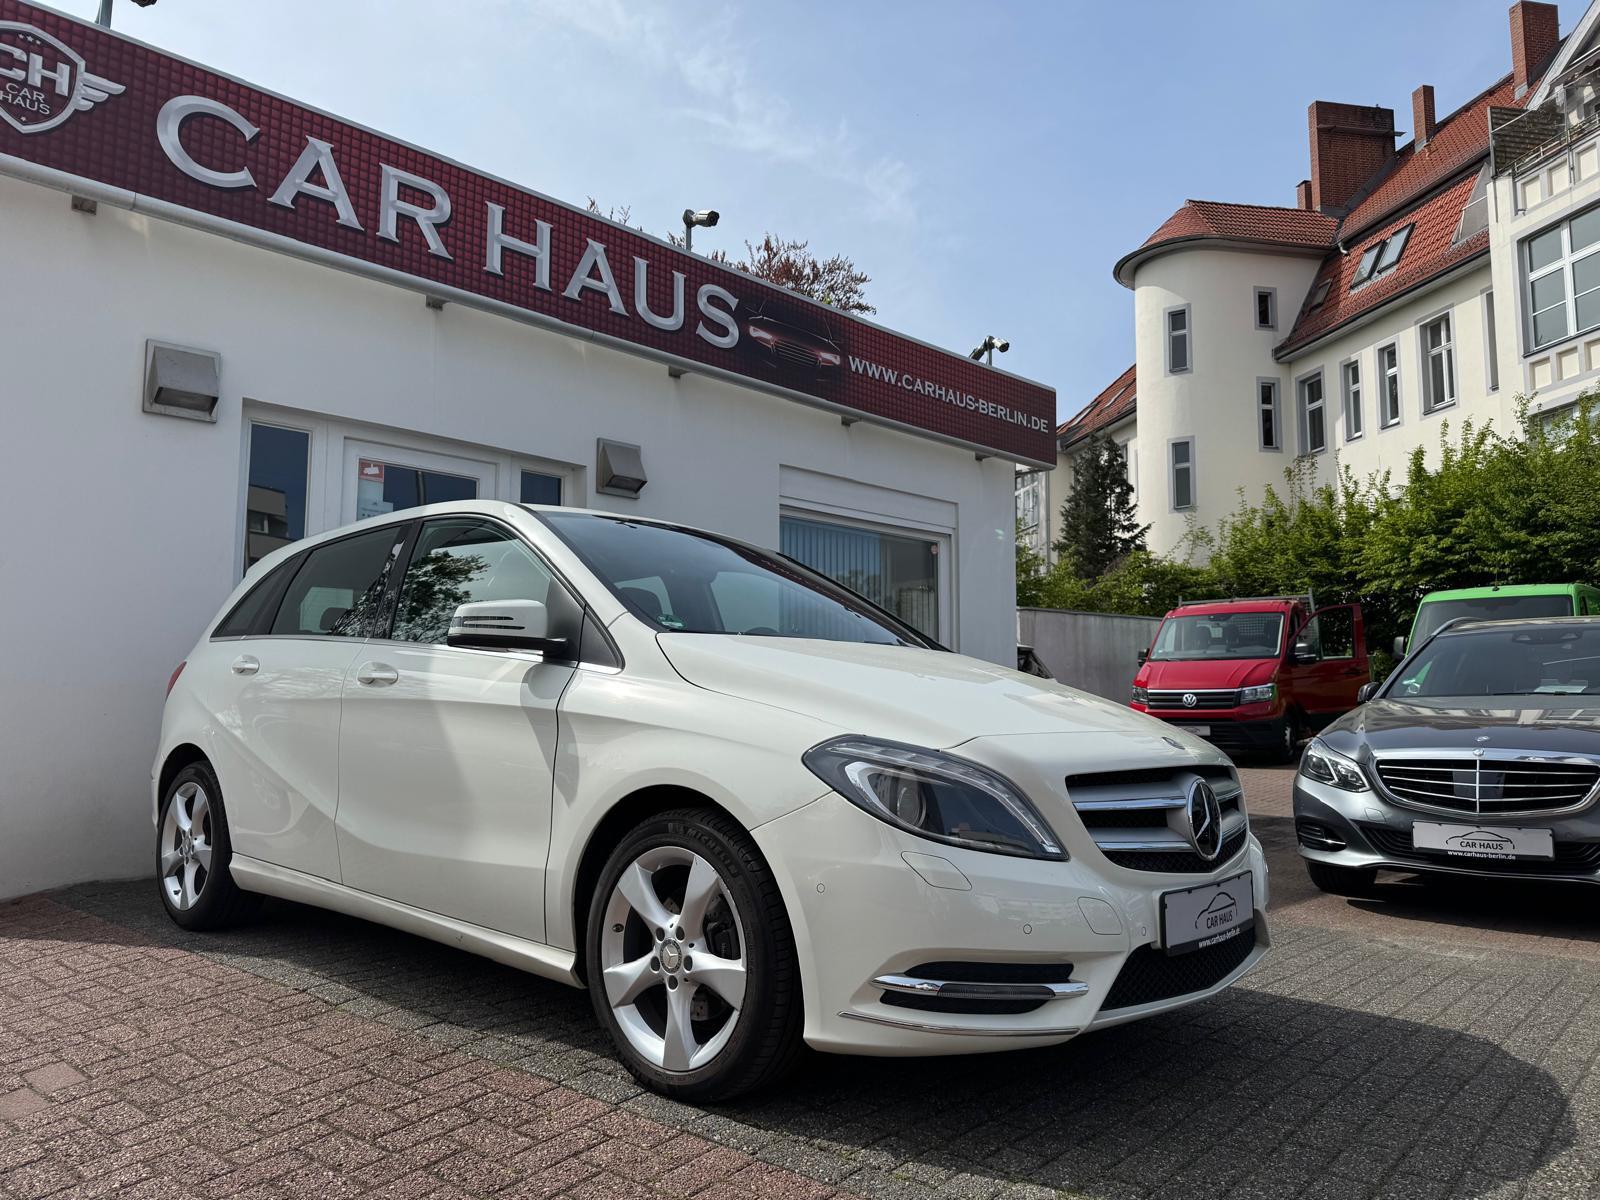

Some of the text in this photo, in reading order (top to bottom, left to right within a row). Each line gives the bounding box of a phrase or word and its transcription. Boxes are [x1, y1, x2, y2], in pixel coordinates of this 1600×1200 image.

[0, 90, 51, 115] HAUS
[6, 82, 45, 103] CAR
[156, 95, 739, 349] CAR HAUS
[848, 354, 1050, 434] WWW.CARHAUS-BERLIN.DE
[1447, 851, 1516, 860] www.carhaus-berlin.de
[1479, 842, 1503, 850] HAUS
[1206, 911, 1232, 929] CAR HAUS
